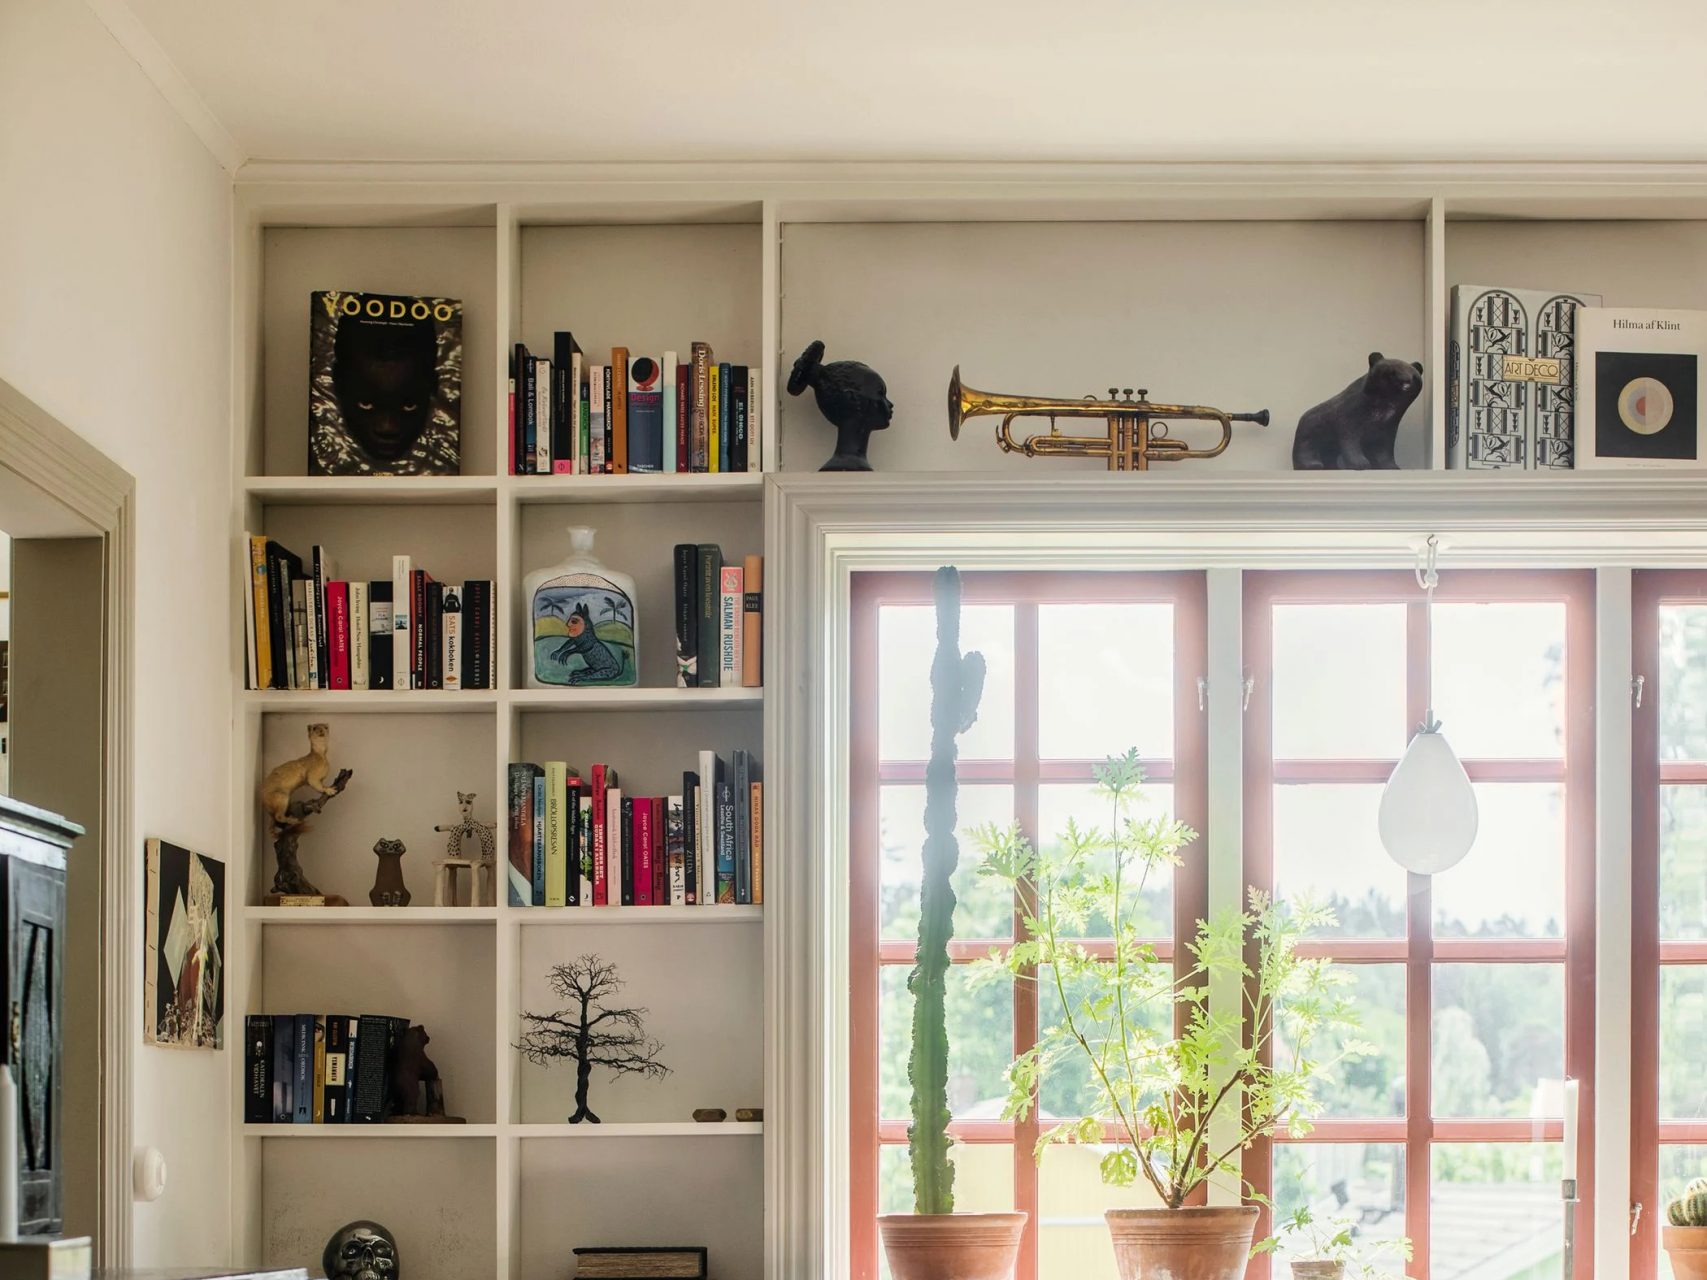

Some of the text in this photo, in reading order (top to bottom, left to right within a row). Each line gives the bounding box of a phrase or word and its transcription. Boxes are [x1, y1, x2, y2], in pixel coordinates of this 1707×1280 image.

[322, 295, 453, 322] VOODOO
[1613, 319, 1681, 331] Hilma af Klint
[527, 378, 535, 393] Bali
[696, 350, 706, 407] Doris Lessing
[1505, 362, 1558, 378] ART DECO
[527, 399, 535, 425] Lombok
[448, 615, 456, 672] SATS kokboken
[724, 596, 733, 671] SALMAN RUSHDIE
[550, 798, 558, 855] BRÖLLOPSRESAN
[725, 805, 733, 861] South Africa
